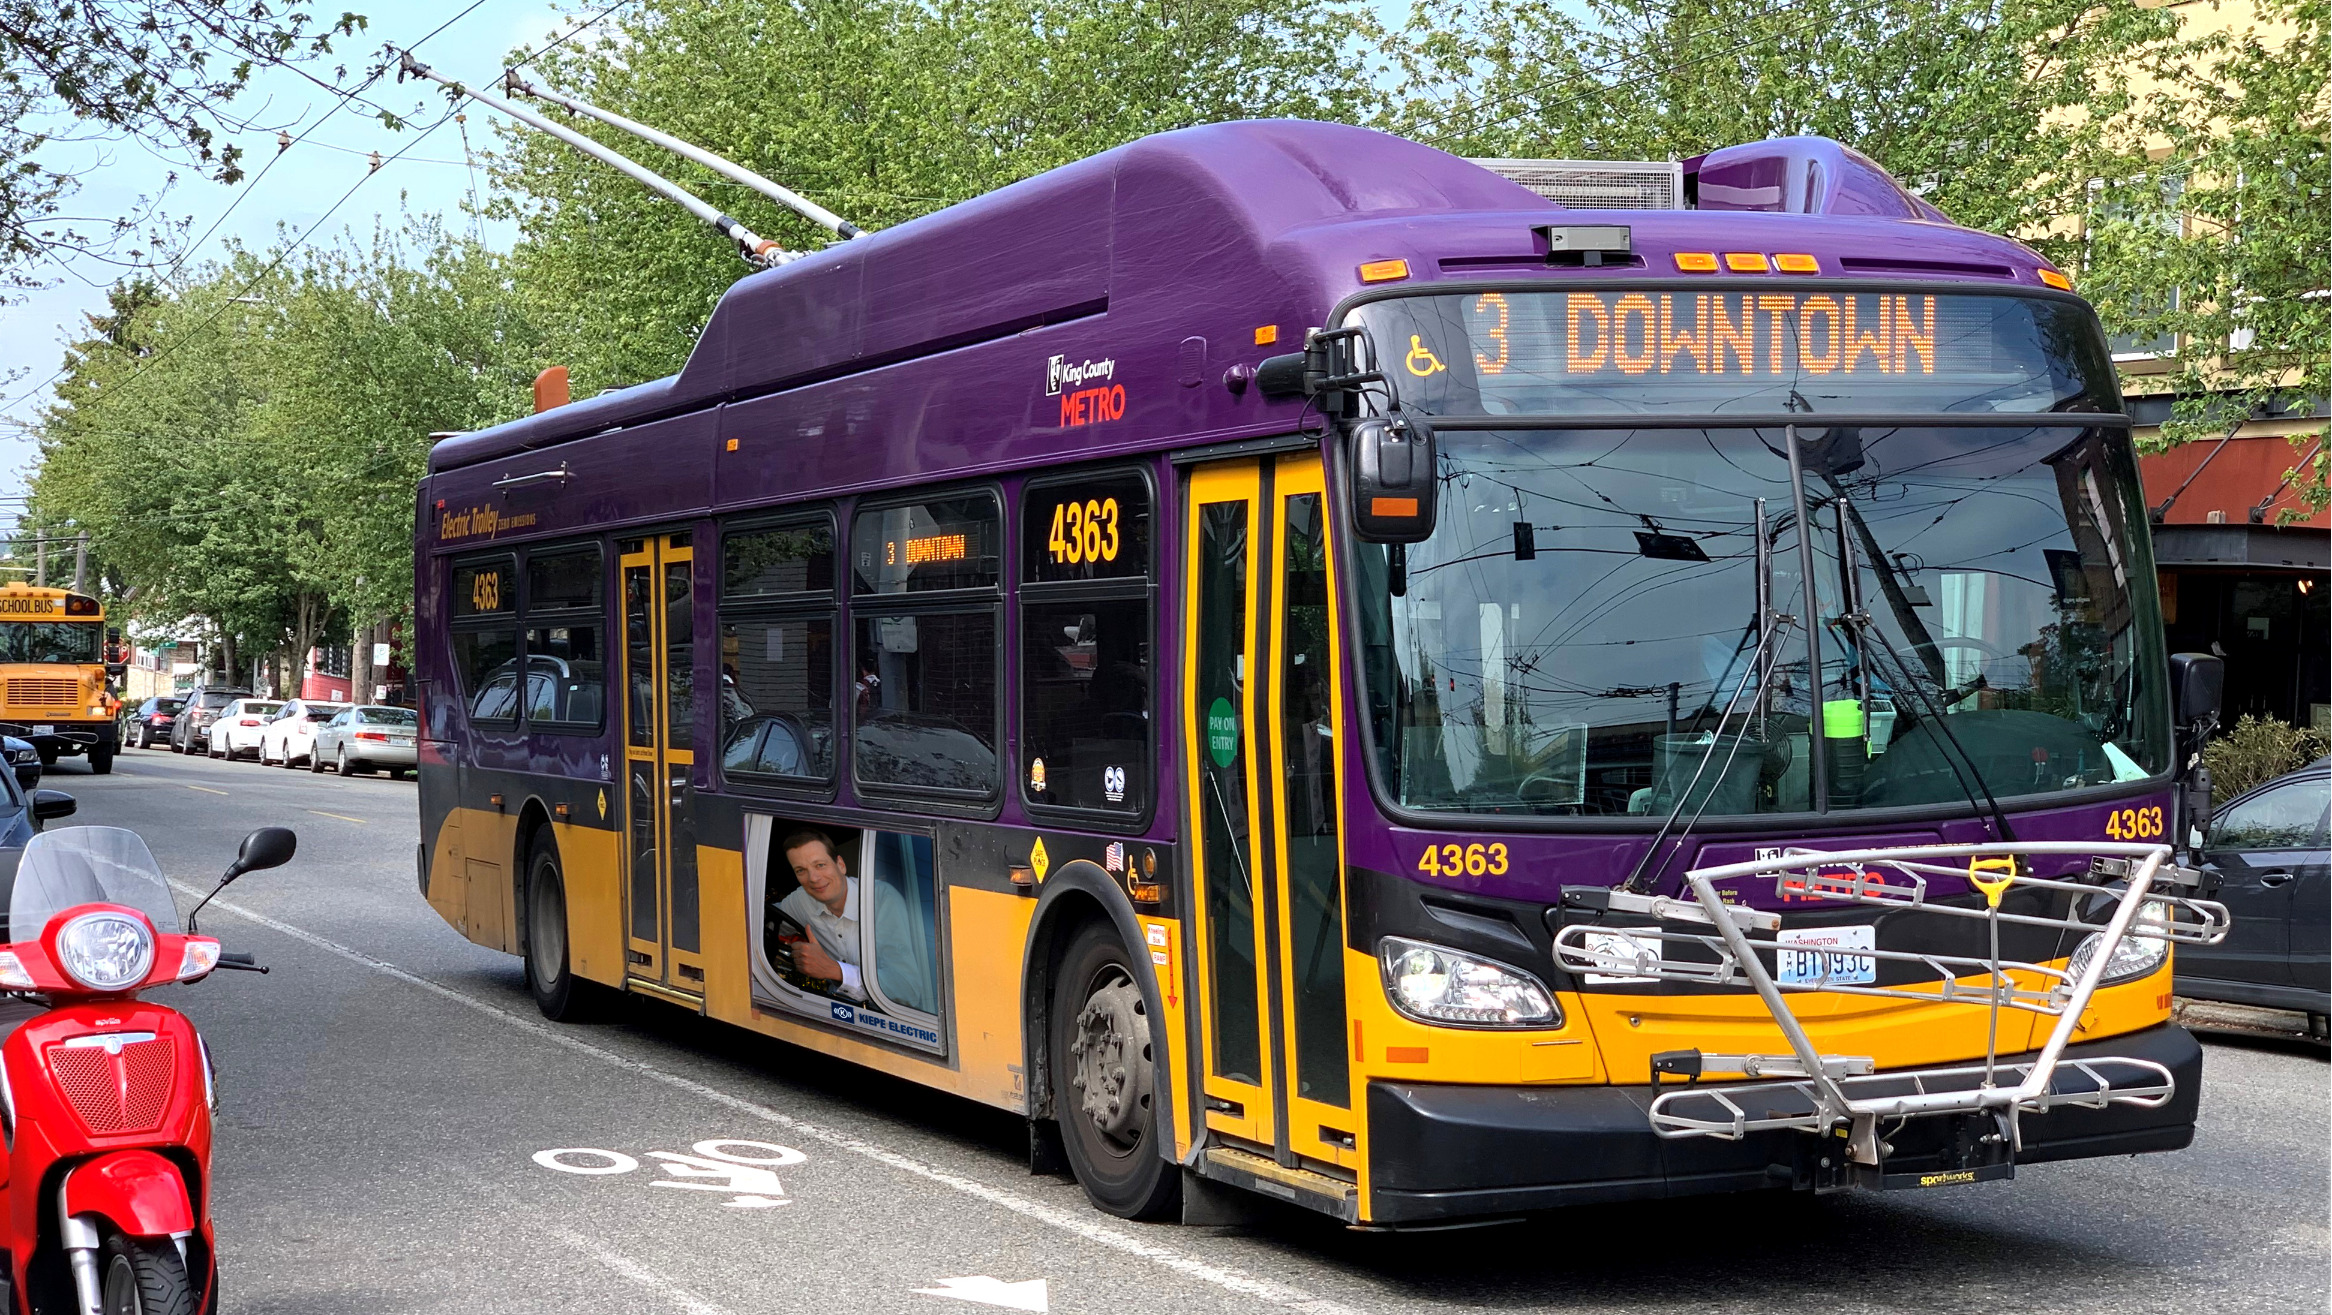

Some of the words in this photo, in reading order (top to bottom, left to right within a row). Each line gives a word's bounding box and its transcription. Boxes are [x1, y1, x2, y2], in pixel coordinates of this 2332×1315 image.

[1476, 293, 1507, 374] 3
[1567, 293, 1935, 375] DOWNTOWN
[1062, 364, 1082, 386] King
[1083, 357, 1115, 380] County
[1060, 384, 1126, 428] METRO
[441, 507, 470, 540] Electric
[472, 503, 499, 540] Trolley
[1049, 498, 1119, 563] 4363
[887, 541, 895, 565] 3
[906, 534, 965, 563] DOWNTOWN
[0, 599, 33, 613] CHOOL
[34, 599, 54, 613] BUS
[473, 572, 498, 610] 4363
[1209, 716, 1222, 731] PAY
[1223, 717, 1235, 731] ON
[1211, 735, 1234, 751] ENTRY
[2105, 806, 2163, 840] 4363
[1418, 843, 1509, 876] 4363
[858, 1013, 886, 1029] KIEPE
[889, 1021, 937, 1043] ELECTRIC
[1920, 1171, 1974, 1187] sportworks
